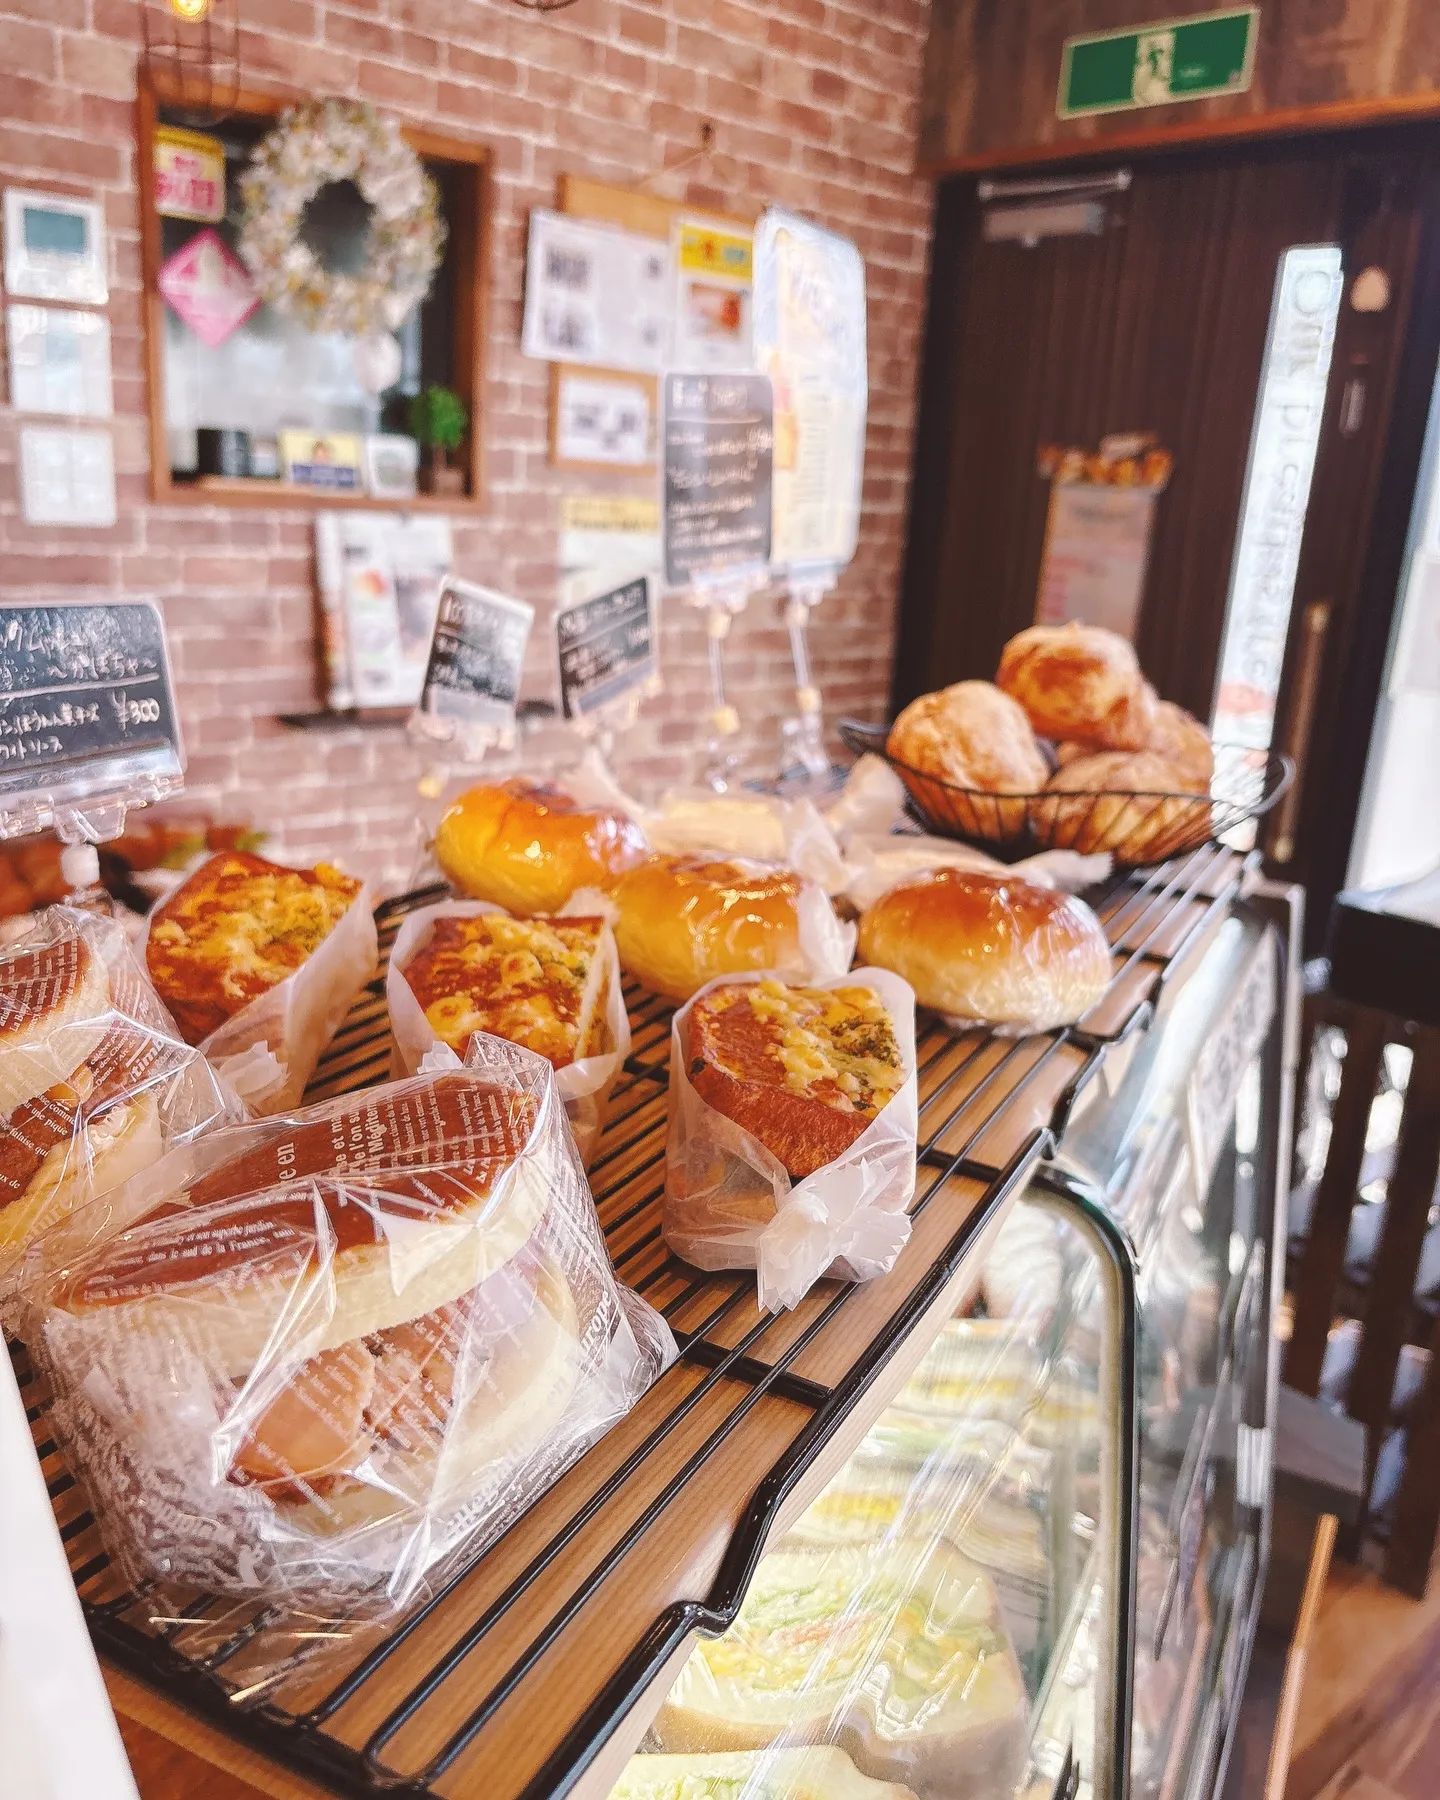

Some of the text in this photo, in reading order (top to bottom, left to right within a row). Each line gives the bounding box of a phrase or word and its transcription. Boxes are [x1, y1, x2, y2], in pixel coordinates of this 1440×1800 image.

[44, 1118, 68, 1136] pique
[9, 1127, 49, 1158] falaise qui
[331, 1135, 346, 1150] et
[348, 1124, 365, 1151] l'on
[277, 1142, 296, 1165] en
[9, 1179, 21, 1189] de
[201, 1242, 213, 1256] de
[215, 1240, 227, 1254] la
